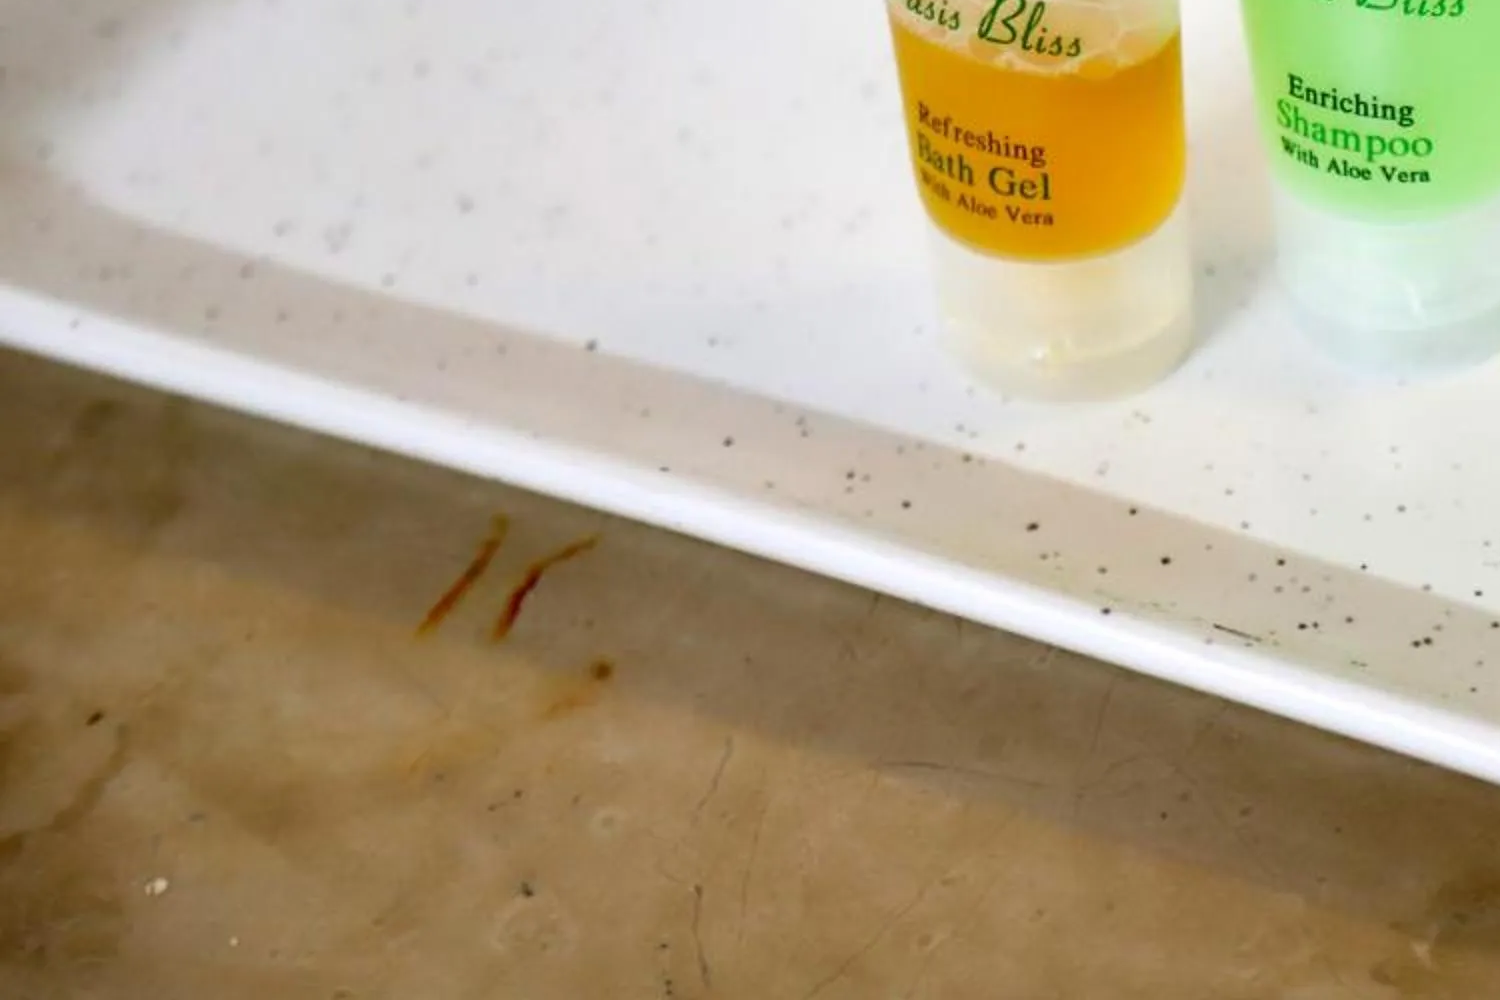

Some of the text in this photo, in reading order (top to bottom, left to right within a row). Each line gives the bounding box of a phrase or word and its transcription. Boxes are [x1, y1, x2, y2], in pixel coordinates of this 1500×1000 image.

[1287, 72, 1415, 128] Enriching
[917, 100, 1047, 169] Refreshing
[1275, 98, 1435, 163] Shampoo
[1280, 134, 1431, 184] With Aloe Vera
[916, 131, 1053, 201] Bath Gel
[957, 192, 998, 220] Aloe
[1004, 204, 1055, 227] Vera
